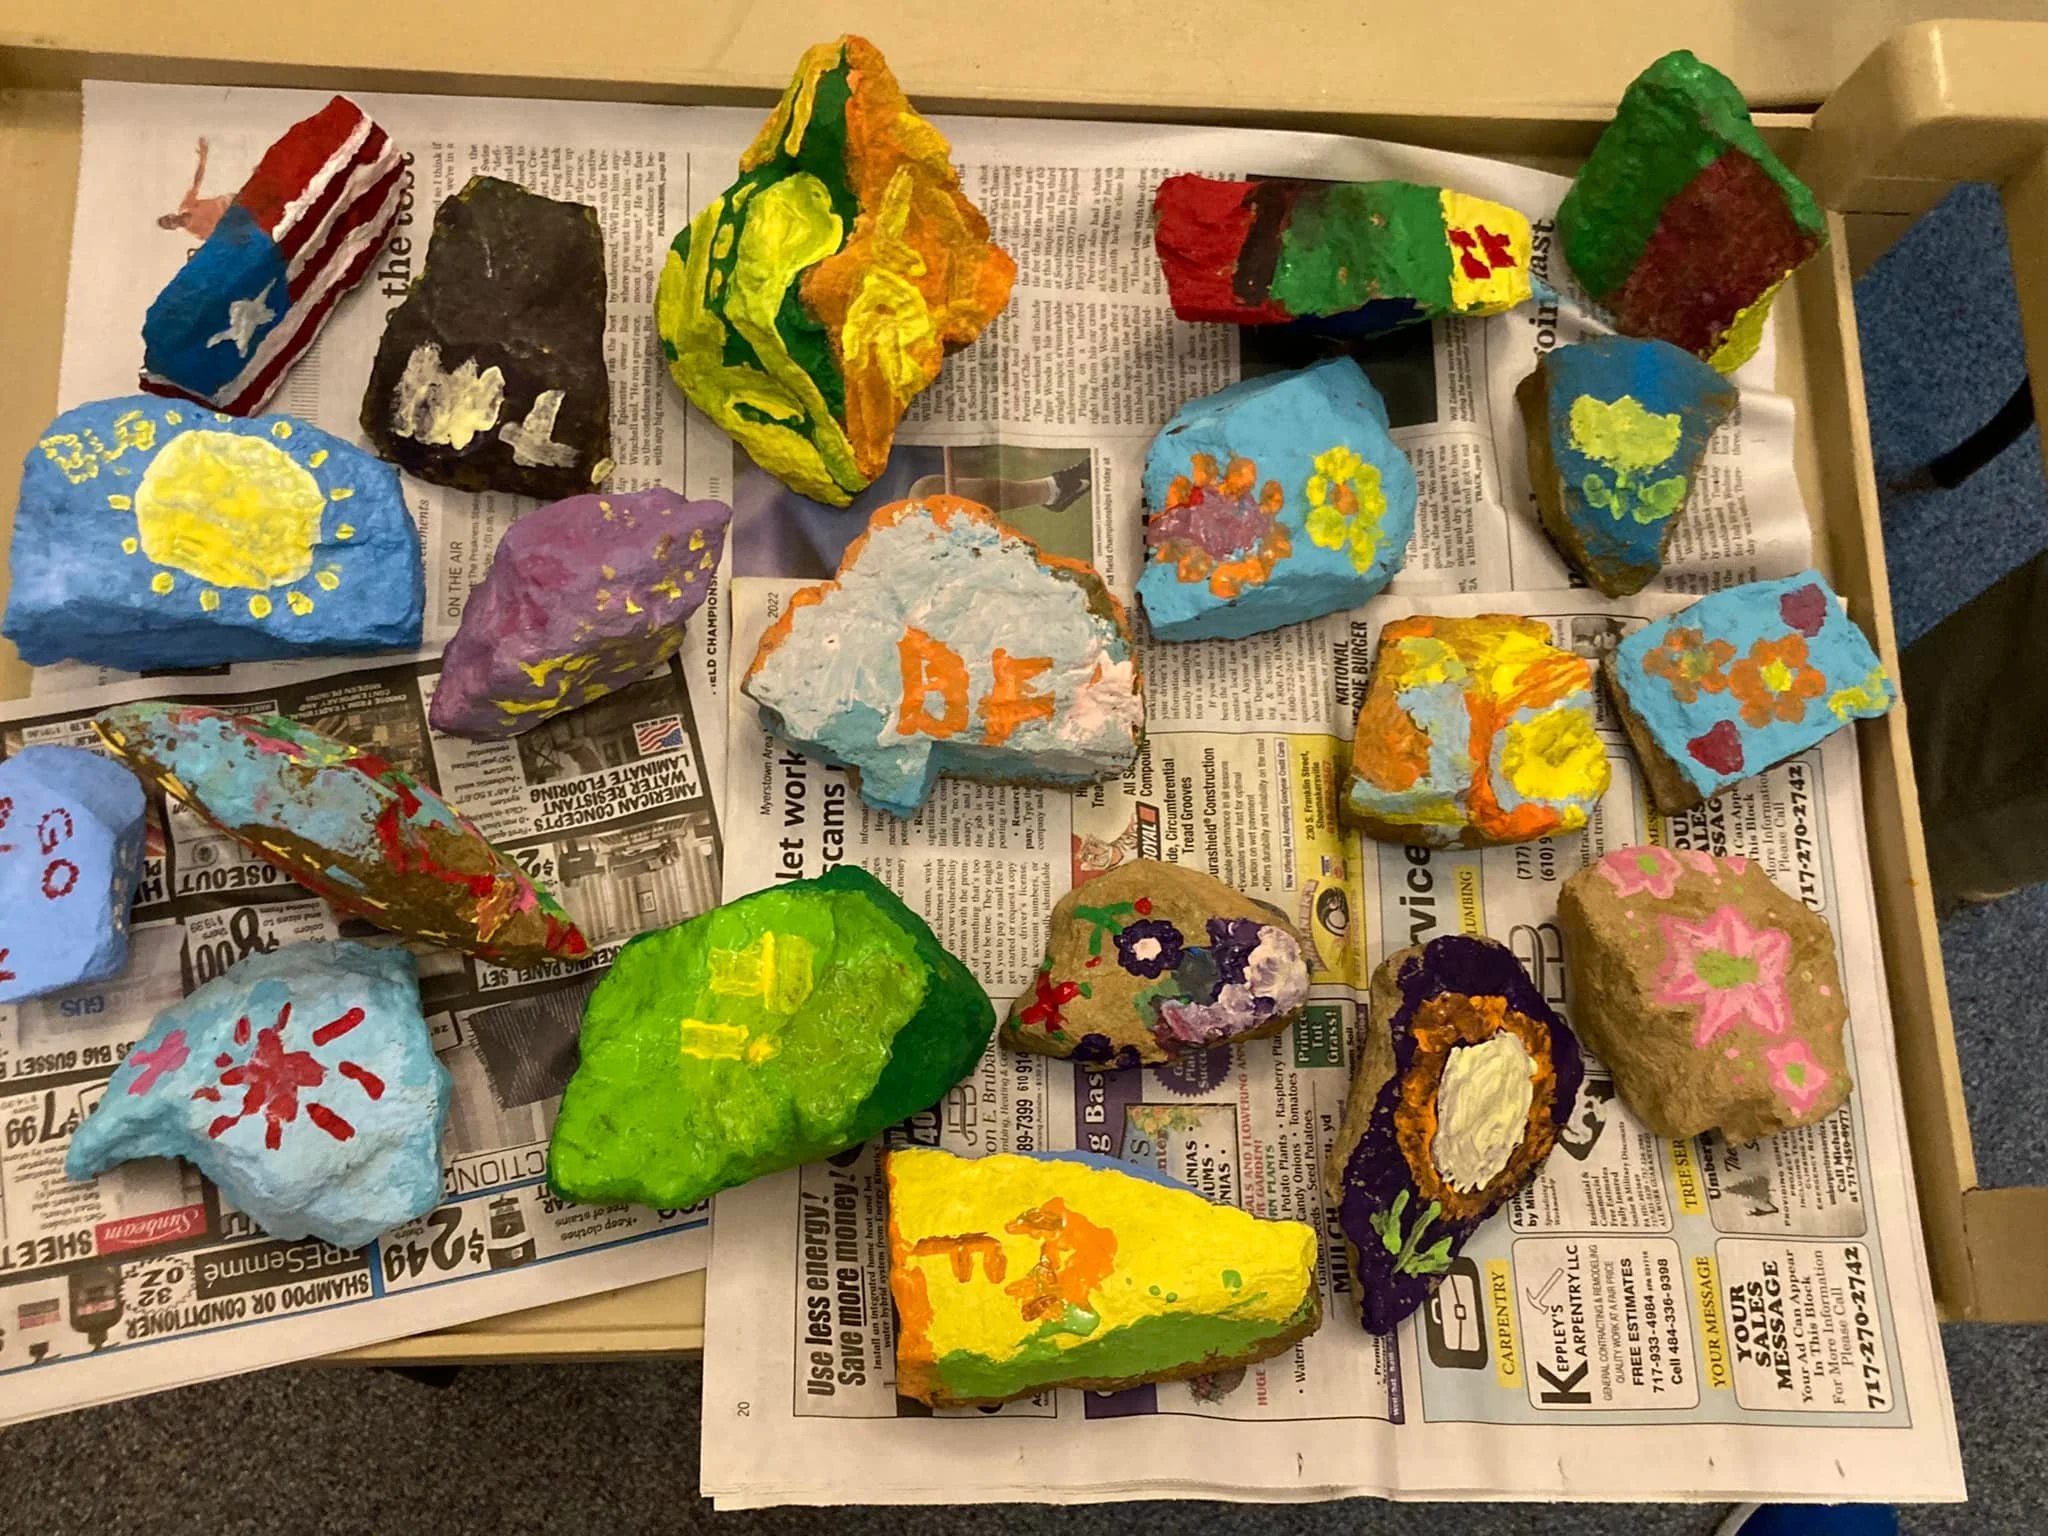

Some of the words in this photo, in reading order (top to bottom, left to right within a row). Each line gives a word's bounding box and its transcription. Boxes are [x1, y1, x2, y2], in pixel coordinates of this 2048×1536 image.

[378, 237, 411, 299] the
[450, 541, 463, 563] AIR
[449, 567, 461, 592] THE
[448, 597, 460, 617] ON
[767, 591, 779, 618] 2022
[1350, 621, 1368, 675] BURGER
[1334, 640, 1349, 705] NATIONAL
[762, 736, 774, 759] Area
[609, 754, 689, 784] LAMINATE
[630, 770, 687, 798] WATER
[1201, 748, 1217, 815] Construction
[530, 775, 605, 803] FLOORING
[541, 786, 627, 817] RESISTANT
[619, 782, 697, 815] AMERICAN
[760, 763, 774, 815] Myerstown
[779, 749, 806, 827] work
[1162, 759, 1177, 840] Circumferential
[1180, 777, 1193, 820] Grooves
[1258, 780, 1268, 811] reliability
[1302, 780, 1312, 812] Franklin
[1312, 762, 1324, 829] Shoemakersville
[533, 805, 614, 832] CONCEPTS
[1281, 806, 1290, 834] Accepting
[1743, 794, 1757, 830] Block
[1774, 802, 1786, 827] Call
[1036, 812, 1045, 850] company
[1182, 824, 1194, 854] Tread
[1221, 811, 1233, 857] performance
[1261, 829, 1271, 862] durability
[1734, 823, 1744, 848] Can
[1789, 765, 1818, 905] 717-270-2742
[776, 838, 804, 879] let
[1515, 846, 1533, 879] (717)
[1540, 848, 1556, 881] (610)
[1778, 832, 1790, 871] Please
[937, 859, 945, 891] attempt
[947, 859, 956, 914] vulnerability
[983, 860, 993, 885] might
[1043, 863, 1051, 911] identifiable
[936, 893, 944, 930] schemes
[1008, 892, 1017, 924] request
[972, 907, 981, 953] something
[1008, 939, 1016, 967] started
[481, 969, 509, 989] SET
[1298, 1014, 1310, 1062] Prince
[1311, 1024, 1323, 1048] Tut
[1326, 1012, 1339, 1063] Grass!
[12, 1051, 77, 1078] GUSSET
[83, 1046, 112, 1067] BIG
[1000, 1078, 1010, 1114] Heating
[1017, 1076, 1028, 1091] 610
[1275, 1061, 1287, 1117] Raspberry
[1289, 1073, 1299, 1126] Tomatoes
[1239, 1073, 1252, 1146] FLOWERING
[1321, 1115, 1335, 1131] yd
[1278, 1135, 1289, 1169] Plants
[1303, 1110, 1315, 1159] Potatoes
[1619, 1121, 1629, 1160] Discounts
[1828, 1119, 1844, 1165] Michael
[1266, 1145, 1276, 1193] PLANTS
[1292, 1143, 1304, 1183] Onions
[1307, 1164, 1318, 1190] Seed
[1836, 1169, 1846, 1193] Call
[1280, 1176, 1292, 1211] Potato
[1582, 1181, 1599, 1226] Residential
[1592, 1176, 1608, 1227] Commercial
[1602, 1167, 1615, 1207] Estimates
[1611, 1171, 1623, 1204] Insured
[1678, 1169, 1698, 1208] TREE
[103, 1209, 199, 1244] Sunbeam
[561, 1223, 602, 1241] clothes
[604, 1218, 633, 1230] Keep
[829, 1170, 858, 1262] money!
[1528, 1213, 1539, 1227] by
[0, 1230, 93, 1271] SHEET
[802, 1192, 830, 1290] energy!
[866, 1241, 875, 1268] home
[1566, 1244, 1579, 1270] LLC
[877, 1251, 888, 1283] system
[1590, 1244, 1602, 1296] REMODELING
[1604, 1261, 1615, 1284] PRICE
[1786, 1249, 1802, 1304] Appear
[139, 1287, 172, 1307] 32
[252, 1292, 277, 1315] OR
[281, 1273, 369, 1310] SHAMPOO
[836, 1268, 862, 1327] more
[867, 1271, 880, 1319] integrated
[878, 1285, 890, 1318] hybrid
[1607, 1286, 1617, 1303] FAIR
[1620, 1258, 1640, 1341] ESTIMATES
[1657, 1259, 1679, 1354] 484-336-9398
[1696, 1256, 1719, 1334] MESSAGE
[1801, 1277, 1815, 1317] Block
[1814, 1250, 1834, 1333] Information
[1830, 1287, 1845, 1315] Call
[126, 1297, 246, 1340] CONDITIONER
[805, 1296, 832, 1346] less
[881, 1321, 891, 1348] water
[1492, 1271, 1515, 1375] CARPENTRY
[1595, 1305, 1609, 1361] CONTRACTING
[1612, 1323, 1621, 1348] WORK
[1730, 1285, 1752, 1363] YOUR
[1747, 1281, 1771, 1368] SALES
[1762, 1260, 1793, 1390] MESSAGE
[1793, 1309, 1804, 1338] Can
[1844, 1247, 1885, 1409] 717-270-2742
[872, 1338, 882, 1370] Install
[1644, 1295, 1665, 1393] 717-933-4984
[1795, 1343, 1808, 1364] Ad
[1809, 1323, 1821, 1356] This
[1827, 1339, 1841, 1374] More
[1839, 1320, 1854, 1366] Please
[807, 1351, 835, 1396] Use
[837, 1331, 866, 1386] Save
[1614, 1350, 1625, 1383] QUALITY
[1630, 1347, 1644, 1386] FREE
[1670, 1359, 1683, 1384] Cell
[1709, 1340, 1727, 1387] YOUR
[1813, 1361, 1825, 1377] In
[1602, 1364, 1612, 1400] GENERAL
[1801, 1367, 1813, 1403] Your
[1832, 1379, 1845, 1404] For
[737, 1402, 750, 1417] 20
